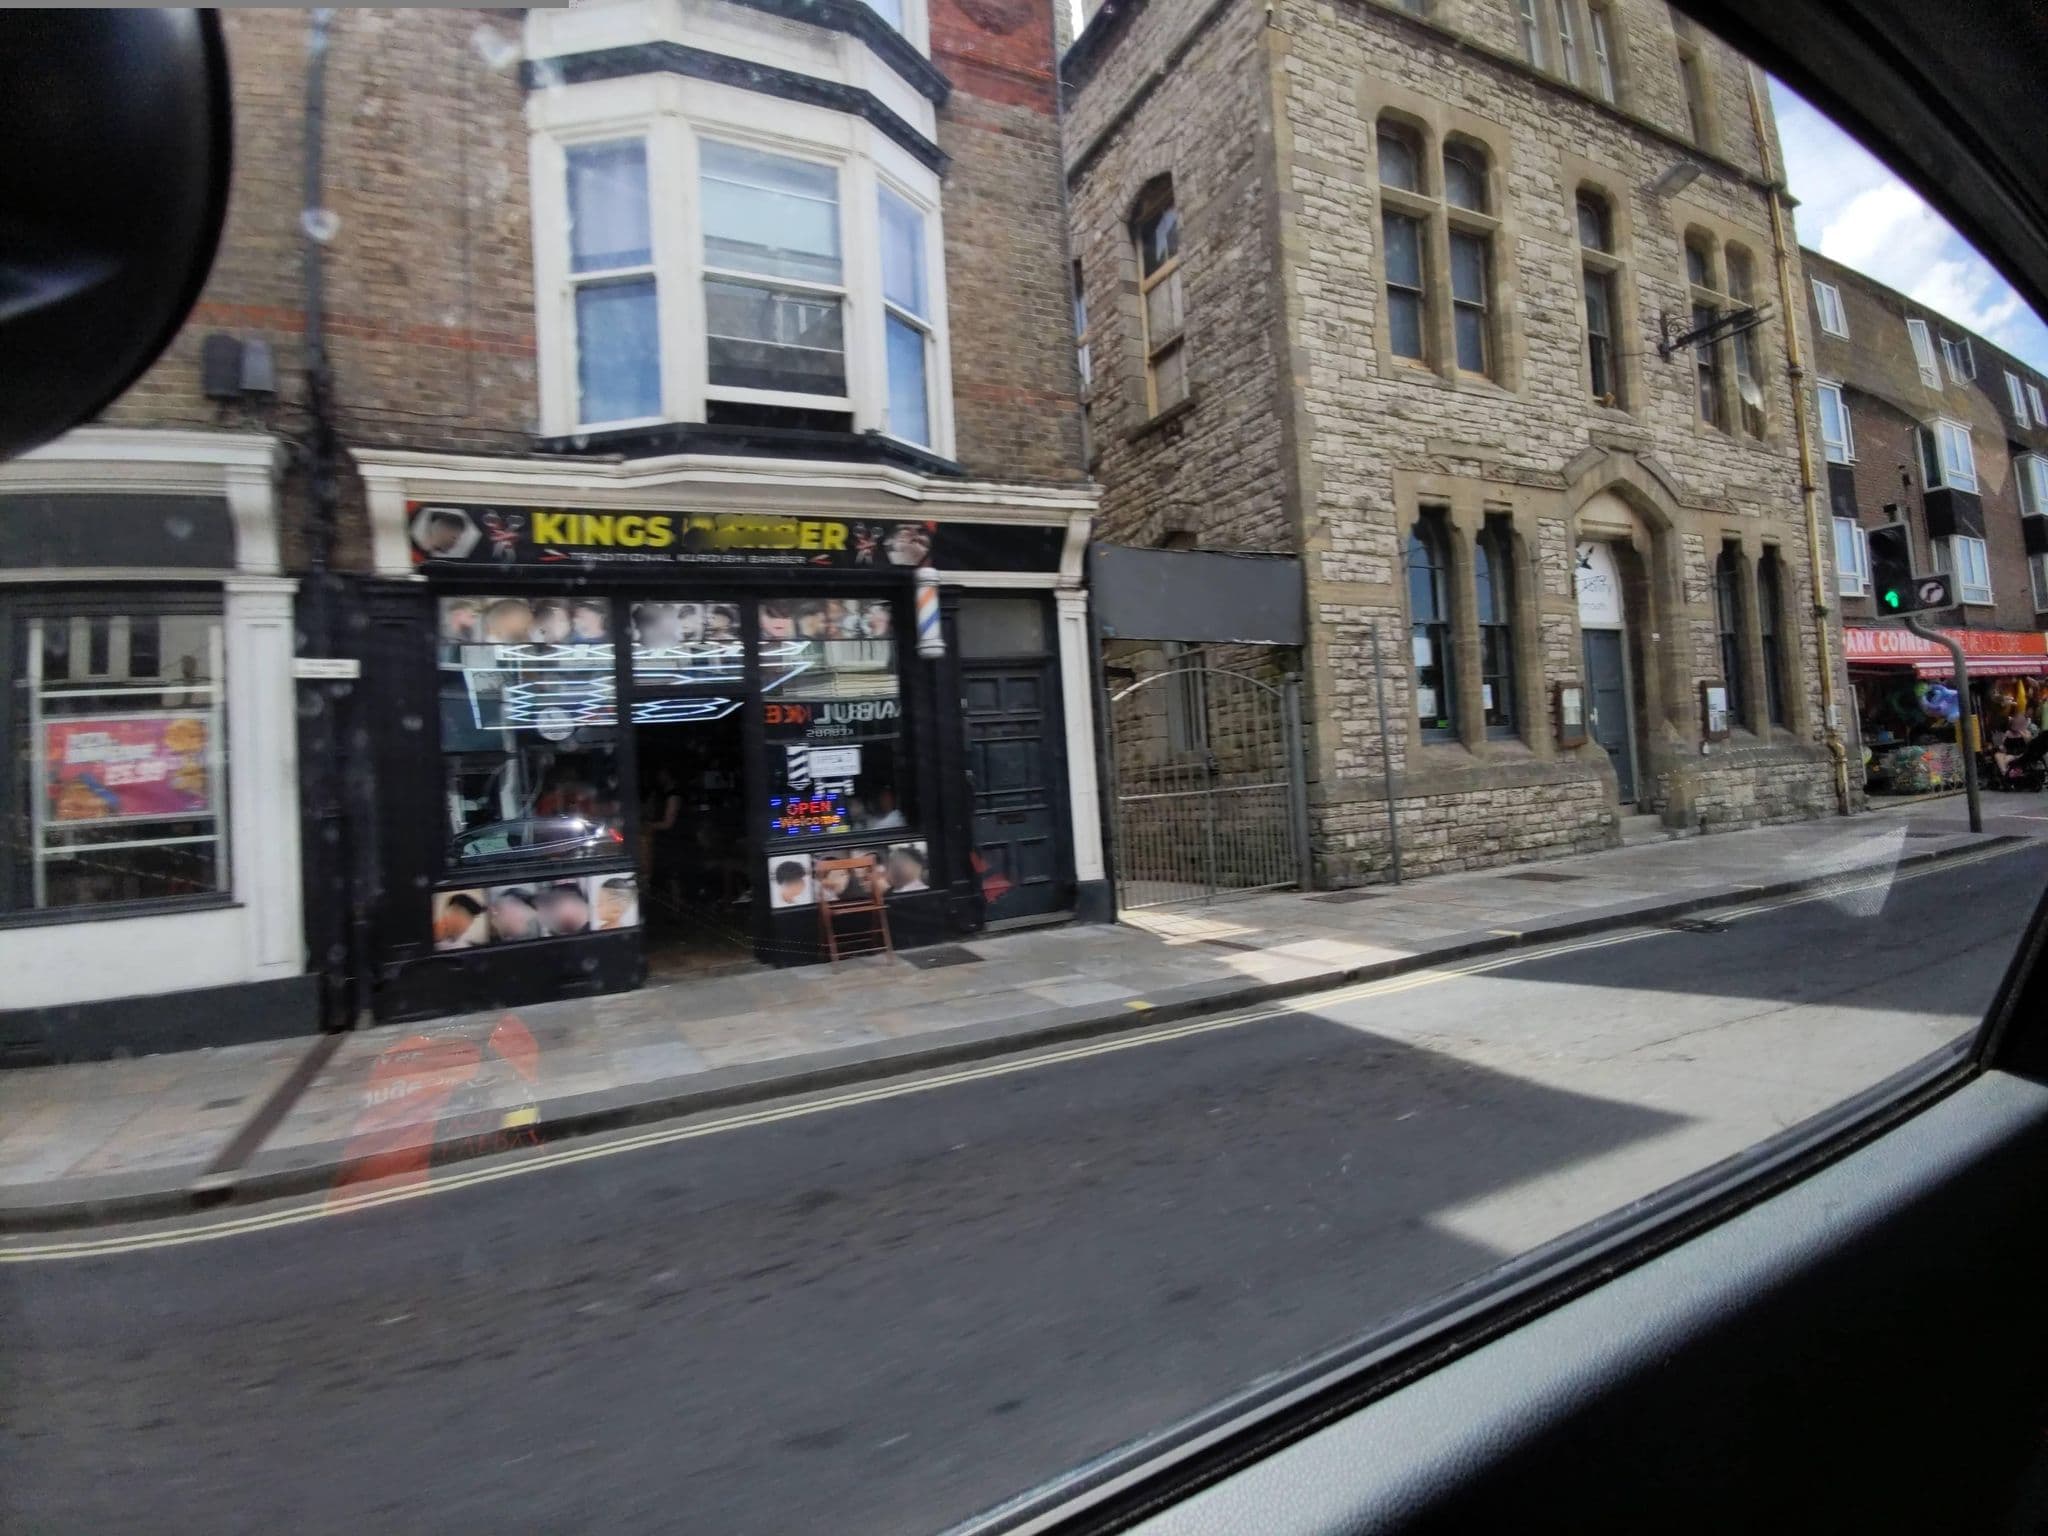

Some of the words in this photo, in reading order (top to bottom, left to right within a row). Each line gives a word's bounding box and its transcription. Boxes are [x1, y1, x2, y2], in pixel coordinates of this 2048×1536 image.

[532, 512, 675, 547] KINGS
[1843, 630, 1876, 653] ARK
[787, 801, 832, 815] OPEN
